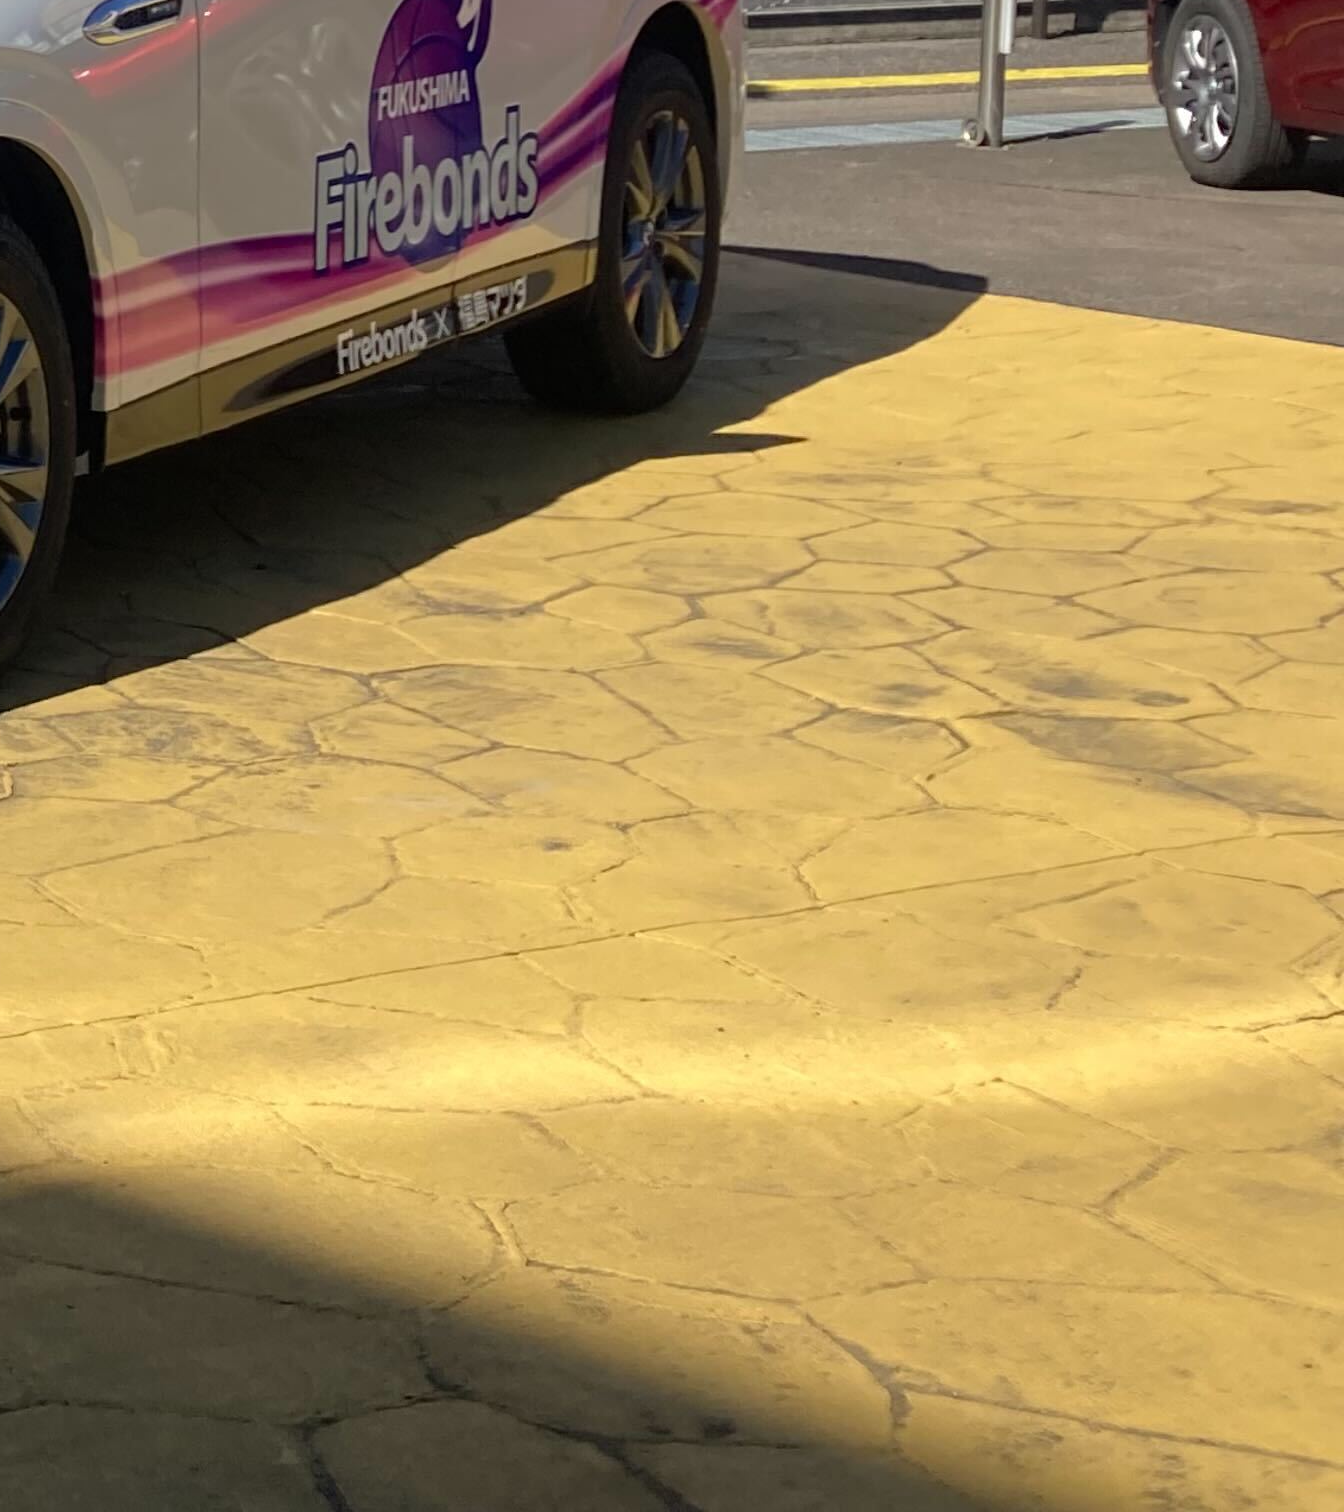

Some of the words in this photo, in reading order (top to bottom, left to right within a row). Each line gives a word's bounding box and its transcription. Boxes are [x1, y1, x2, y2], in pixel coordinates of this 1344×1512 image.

[377, 69, 471, 121] FUKUSHIMA
[314, 104, 540, 274] Firebonds
[337, 308, 428, 375] Firebonds
